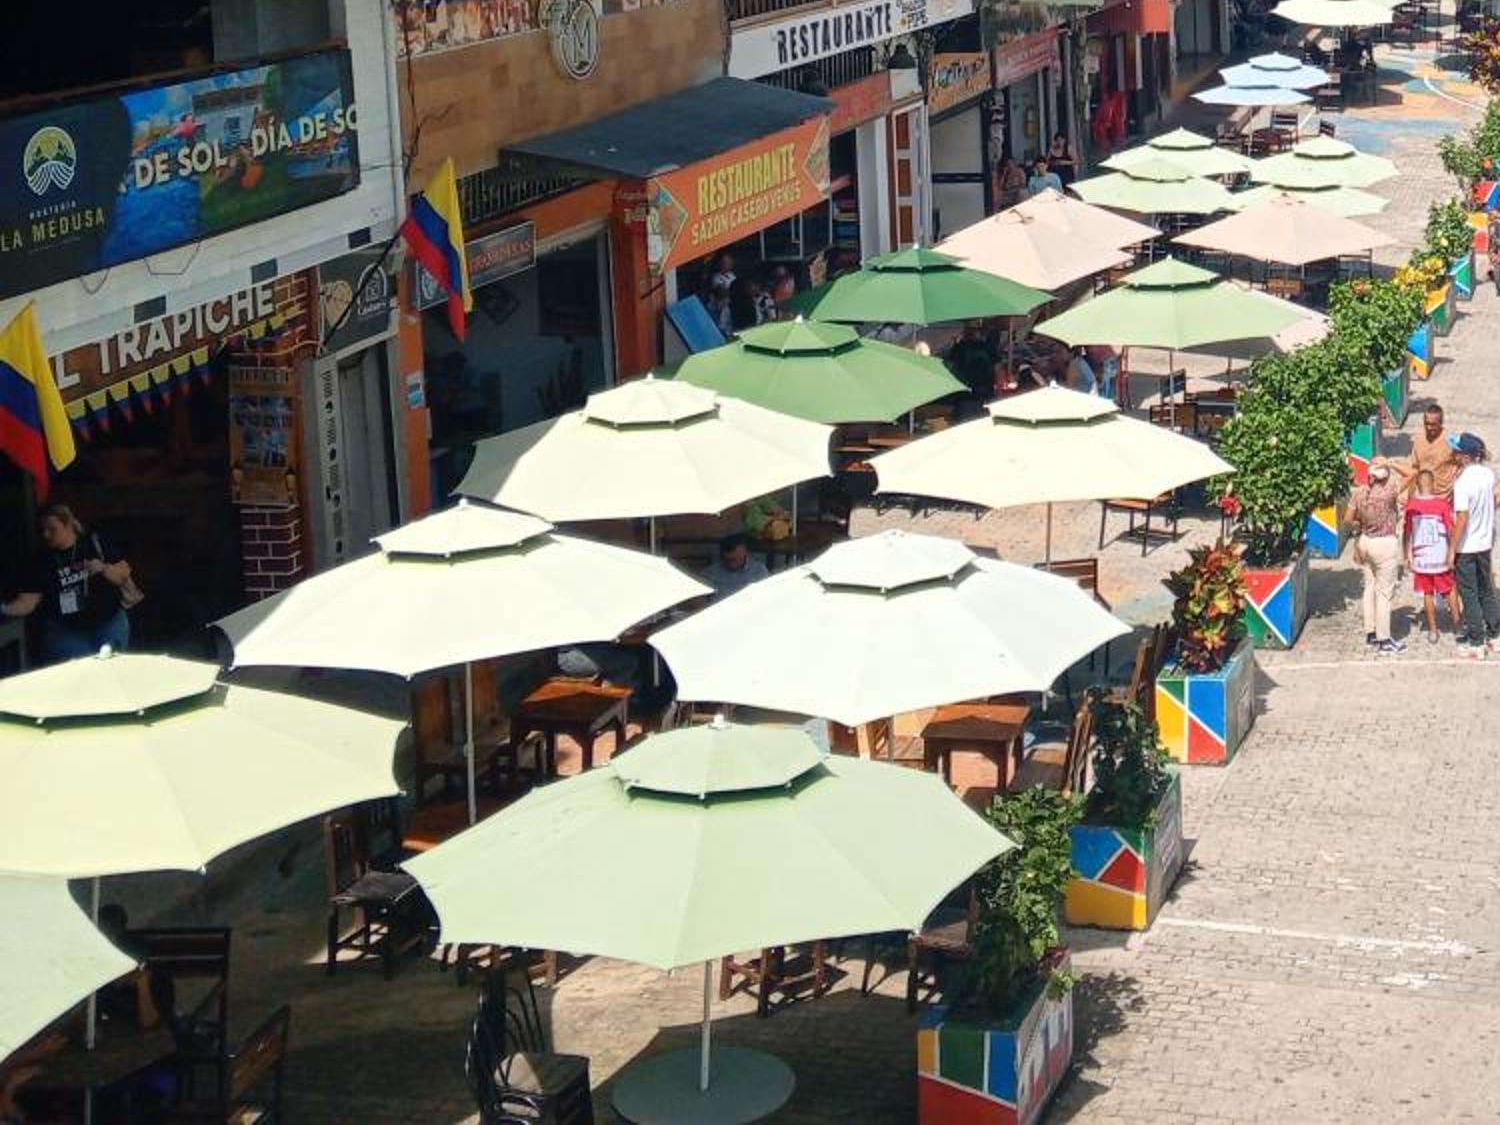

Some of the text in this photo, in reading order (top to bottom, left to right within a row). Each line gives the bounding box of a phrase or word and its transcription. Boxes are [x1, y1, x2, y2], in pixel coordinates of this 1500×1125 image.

[777, 2, 892, 64] RESTAURANTE
[135, 154, 172, 188] DE
[252, 117, 293, 157] DÍA
[300, 115, 334, 143] DE
[697, 143, 796, 216] RESTAURANTE
[1, 229, 23, 252] LA
[31, 207, 106, 242] MEDUSA
[731, 196, 770, 228] CASERO
[54, 281, 277, 390] L TRAPICHE
